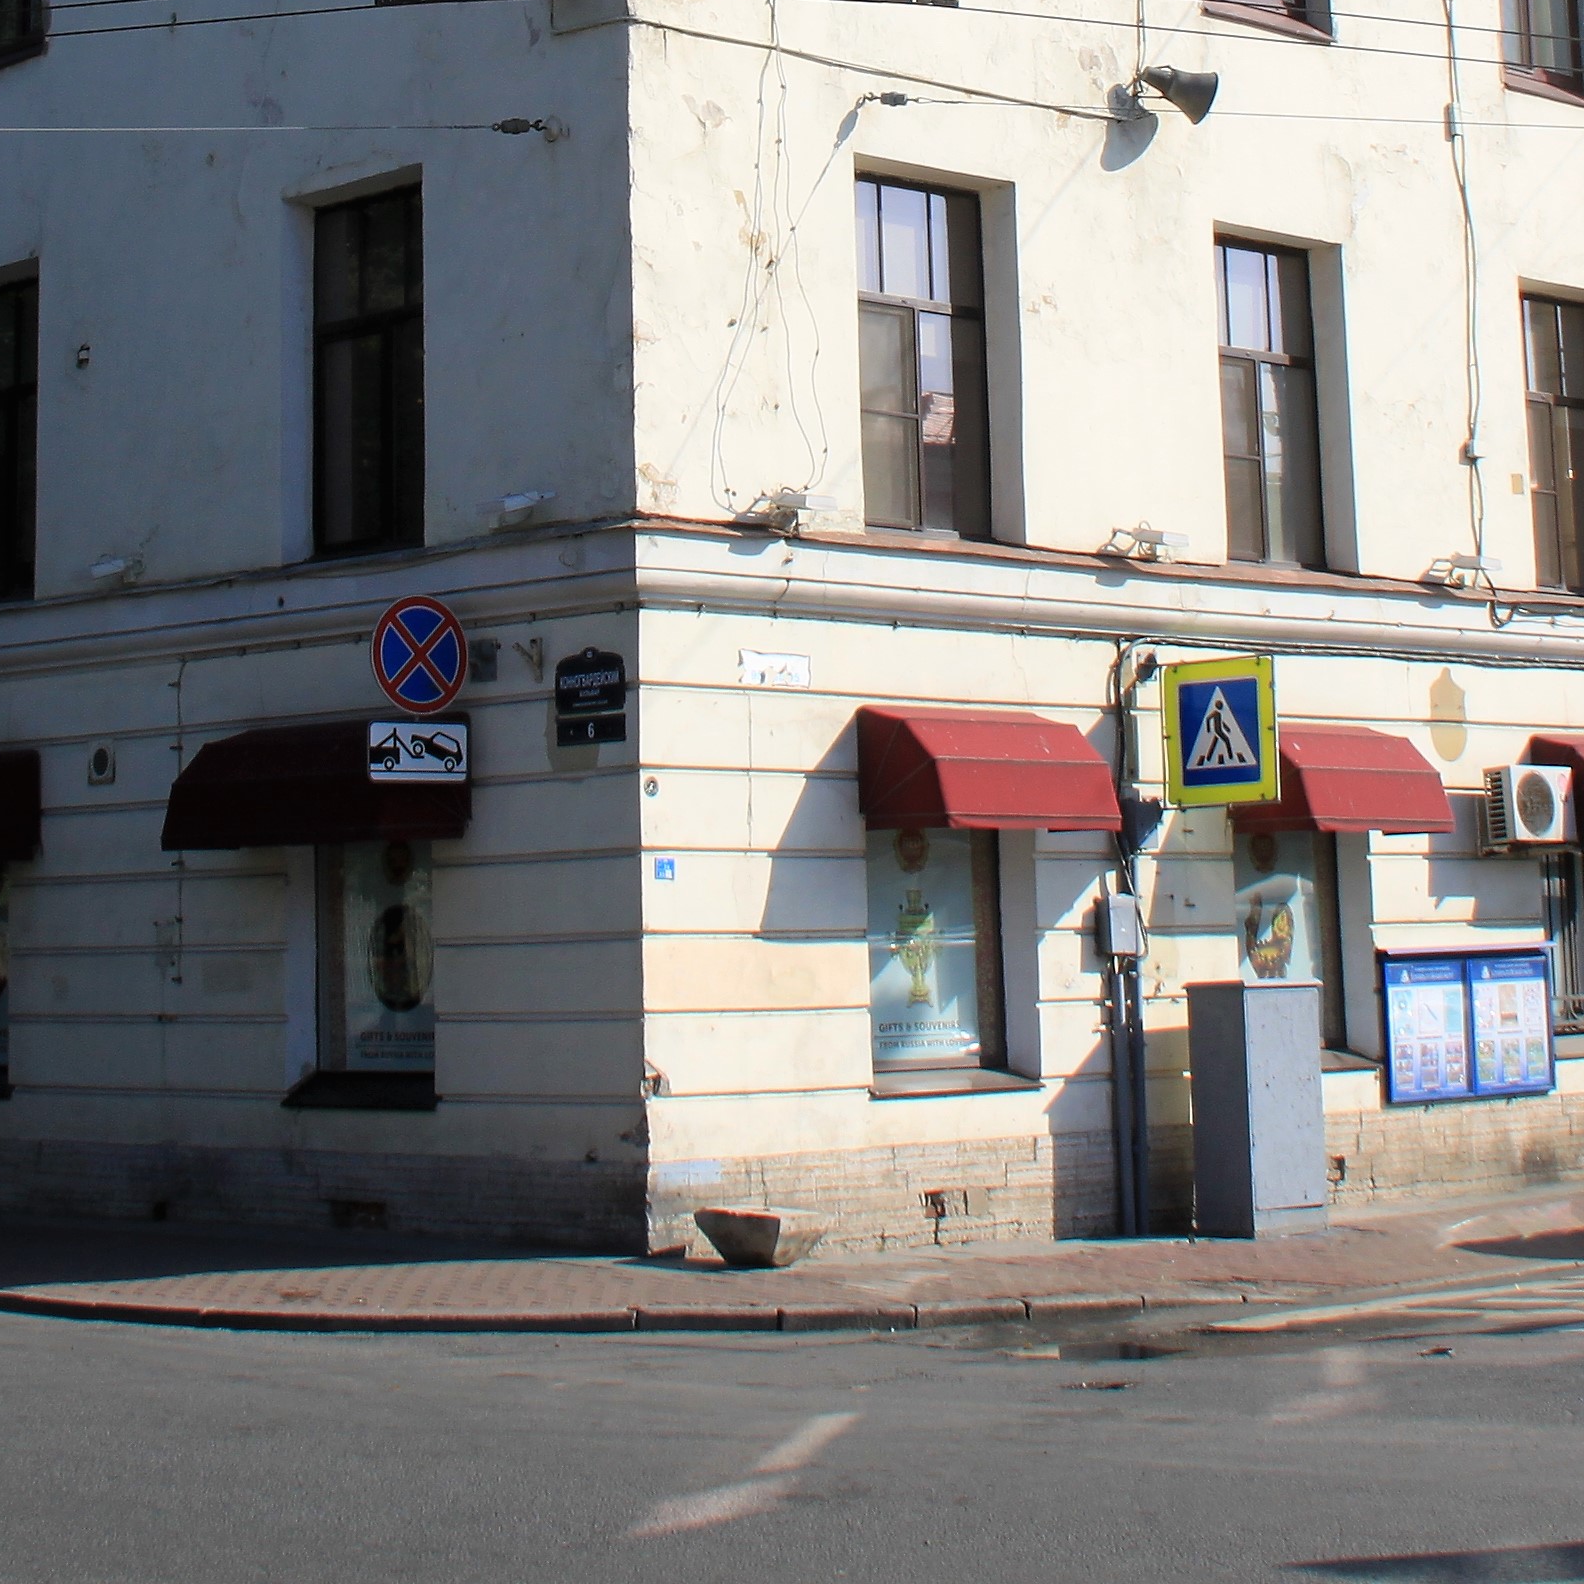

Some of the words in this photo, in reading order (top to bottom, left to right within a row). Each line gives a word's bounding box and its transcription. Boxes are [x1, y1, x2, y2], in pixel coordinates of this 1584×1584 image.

[587, 722, 595, 739] 6
[879, 1022, 904, 1033] GIFTS
[914, 1019, 961, 1030] SOUVENIRS
[360, 1031, 384, 1041] GIFTS
